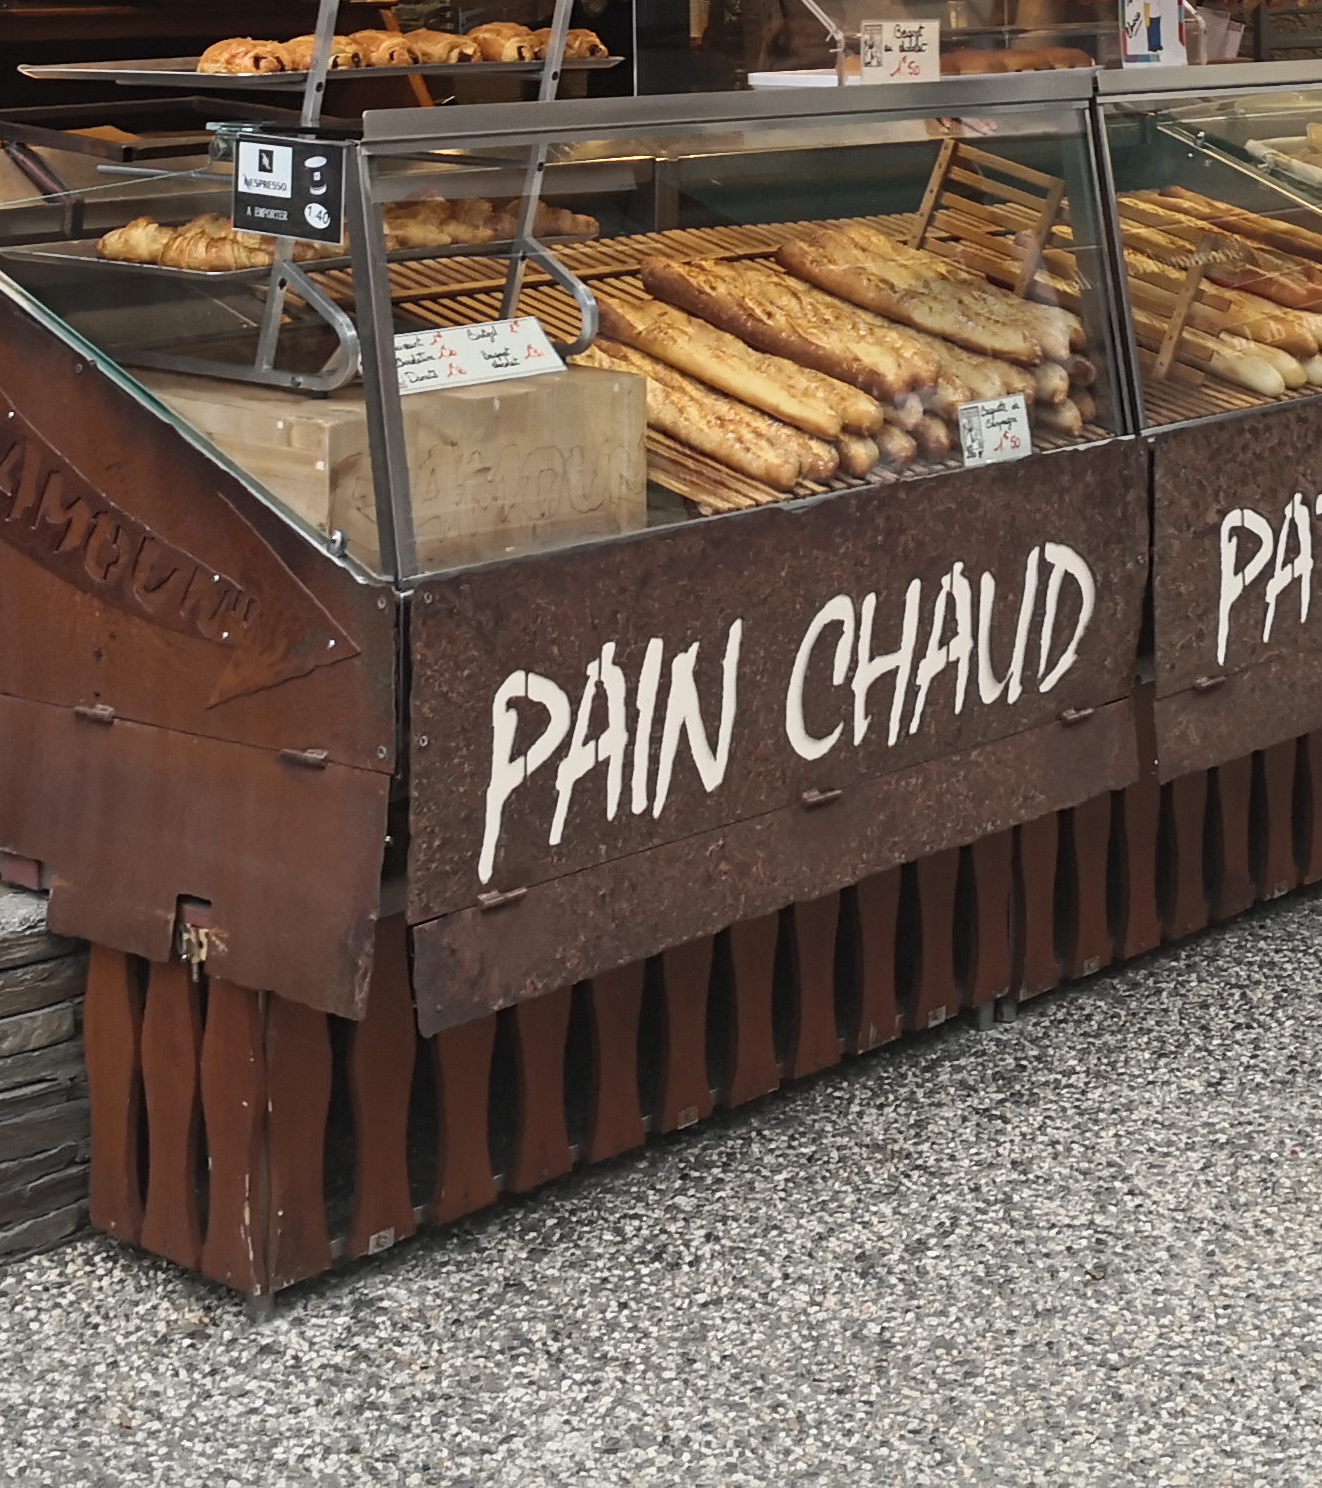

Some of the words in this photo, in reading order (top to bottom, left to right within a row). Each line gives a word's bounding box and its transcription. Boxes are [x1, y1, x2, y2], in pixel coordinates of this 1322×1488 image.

[241, 173, 288, 192] NESPRESSO
[478, 618, 743, 884] PAIN
[786, 541, 1096, 761] CHAUD
